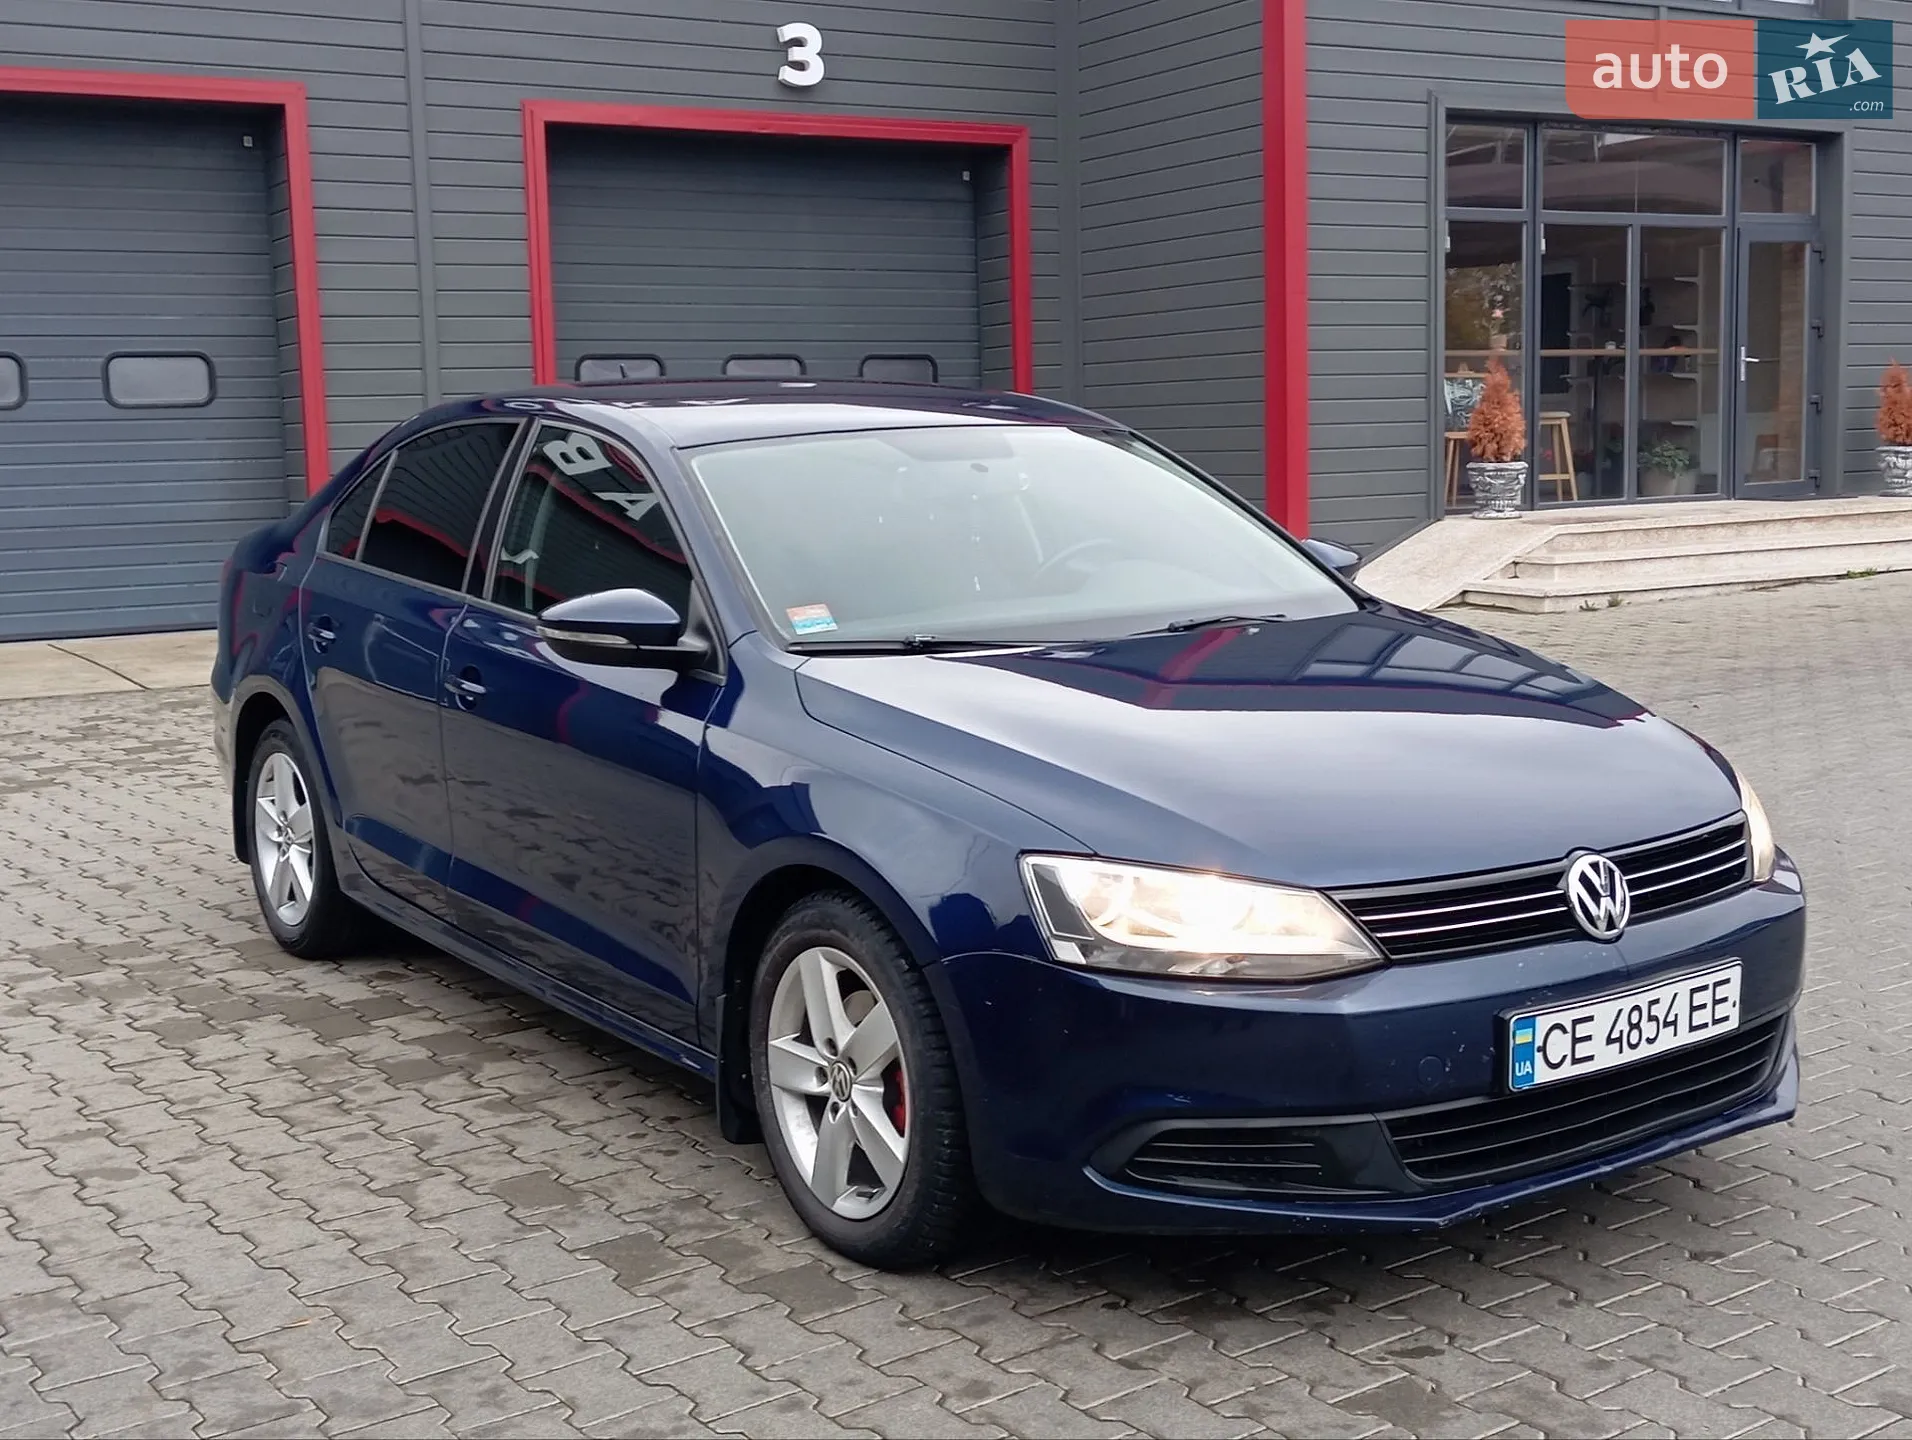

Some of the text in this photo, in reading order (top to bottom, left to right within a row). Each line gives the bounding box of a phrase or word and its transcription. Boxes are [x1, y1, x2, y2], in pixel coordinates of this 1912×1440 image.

[776, 22, 824, 87] 3
[1541, 977, 1732, 1069] CE 4854 EE
[1515, 1060, 1533, 1077] UA
